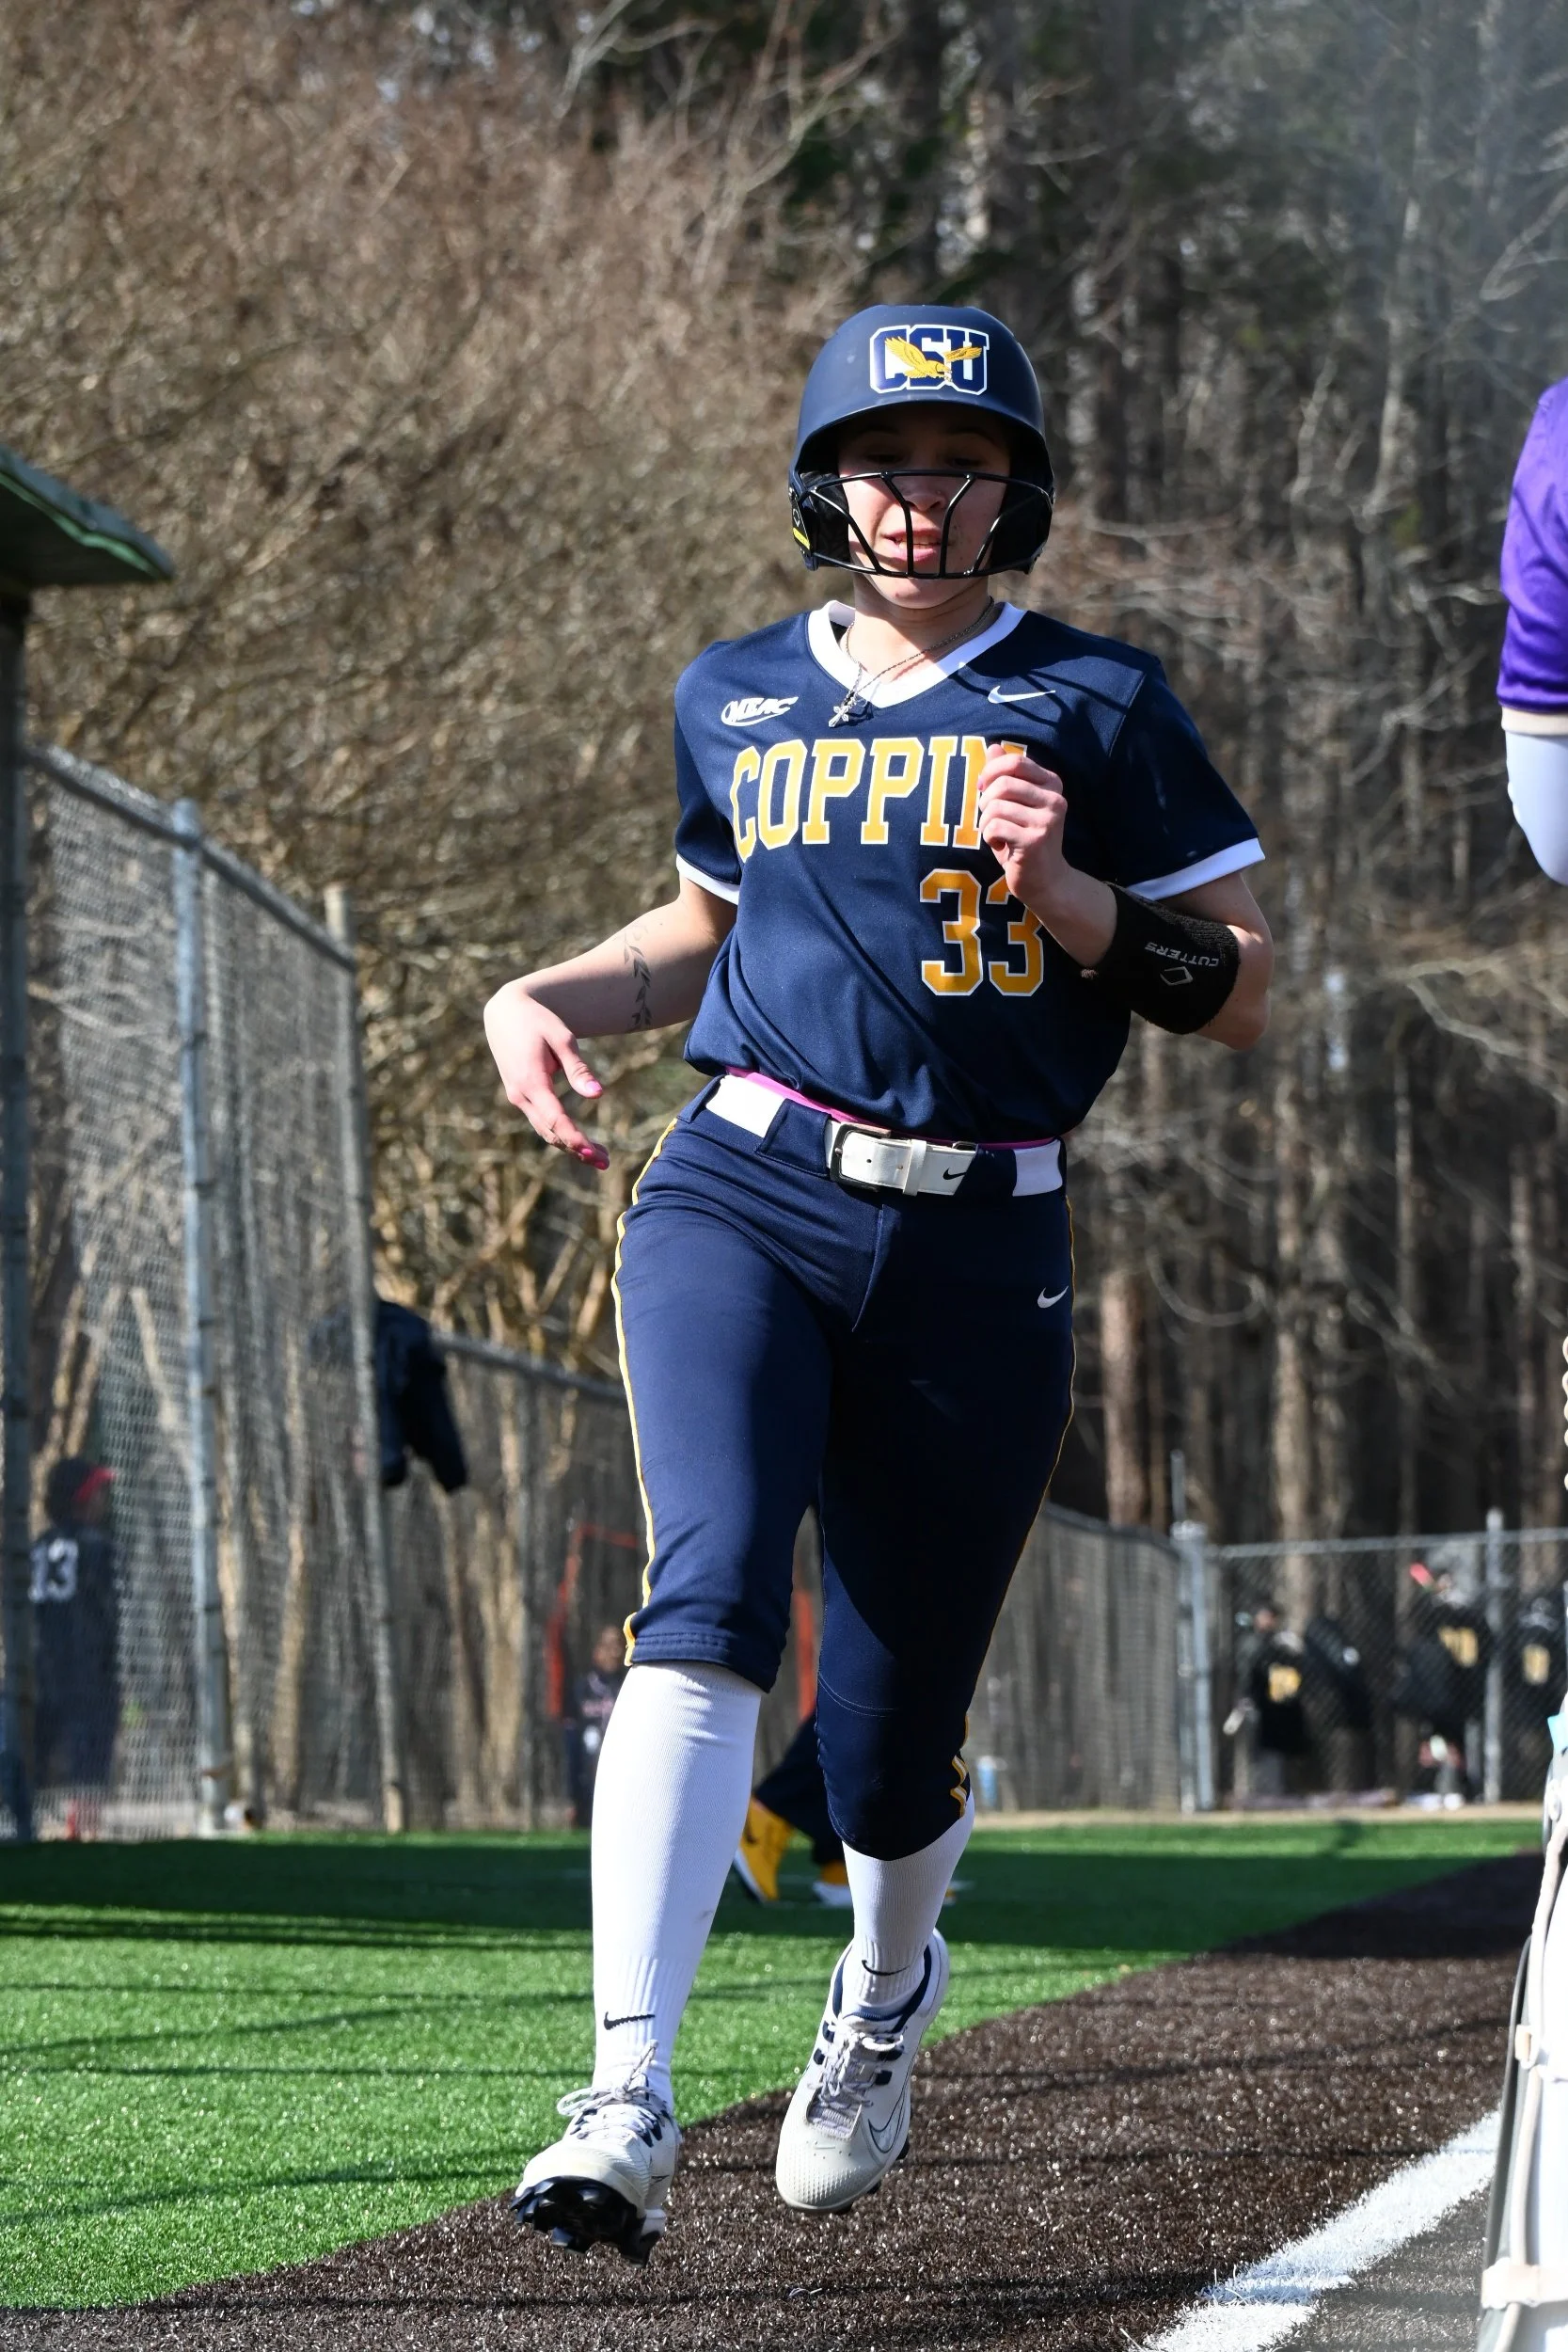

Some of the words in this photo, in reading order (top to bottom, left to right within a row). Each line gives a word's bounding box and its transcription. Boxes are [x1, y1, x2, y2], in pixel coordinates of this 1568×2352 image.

[870, 325, 990, 395] CSU
[920, 868, 1044, 996] 33
[1145, 942, 1219, 966] CUTTERS
